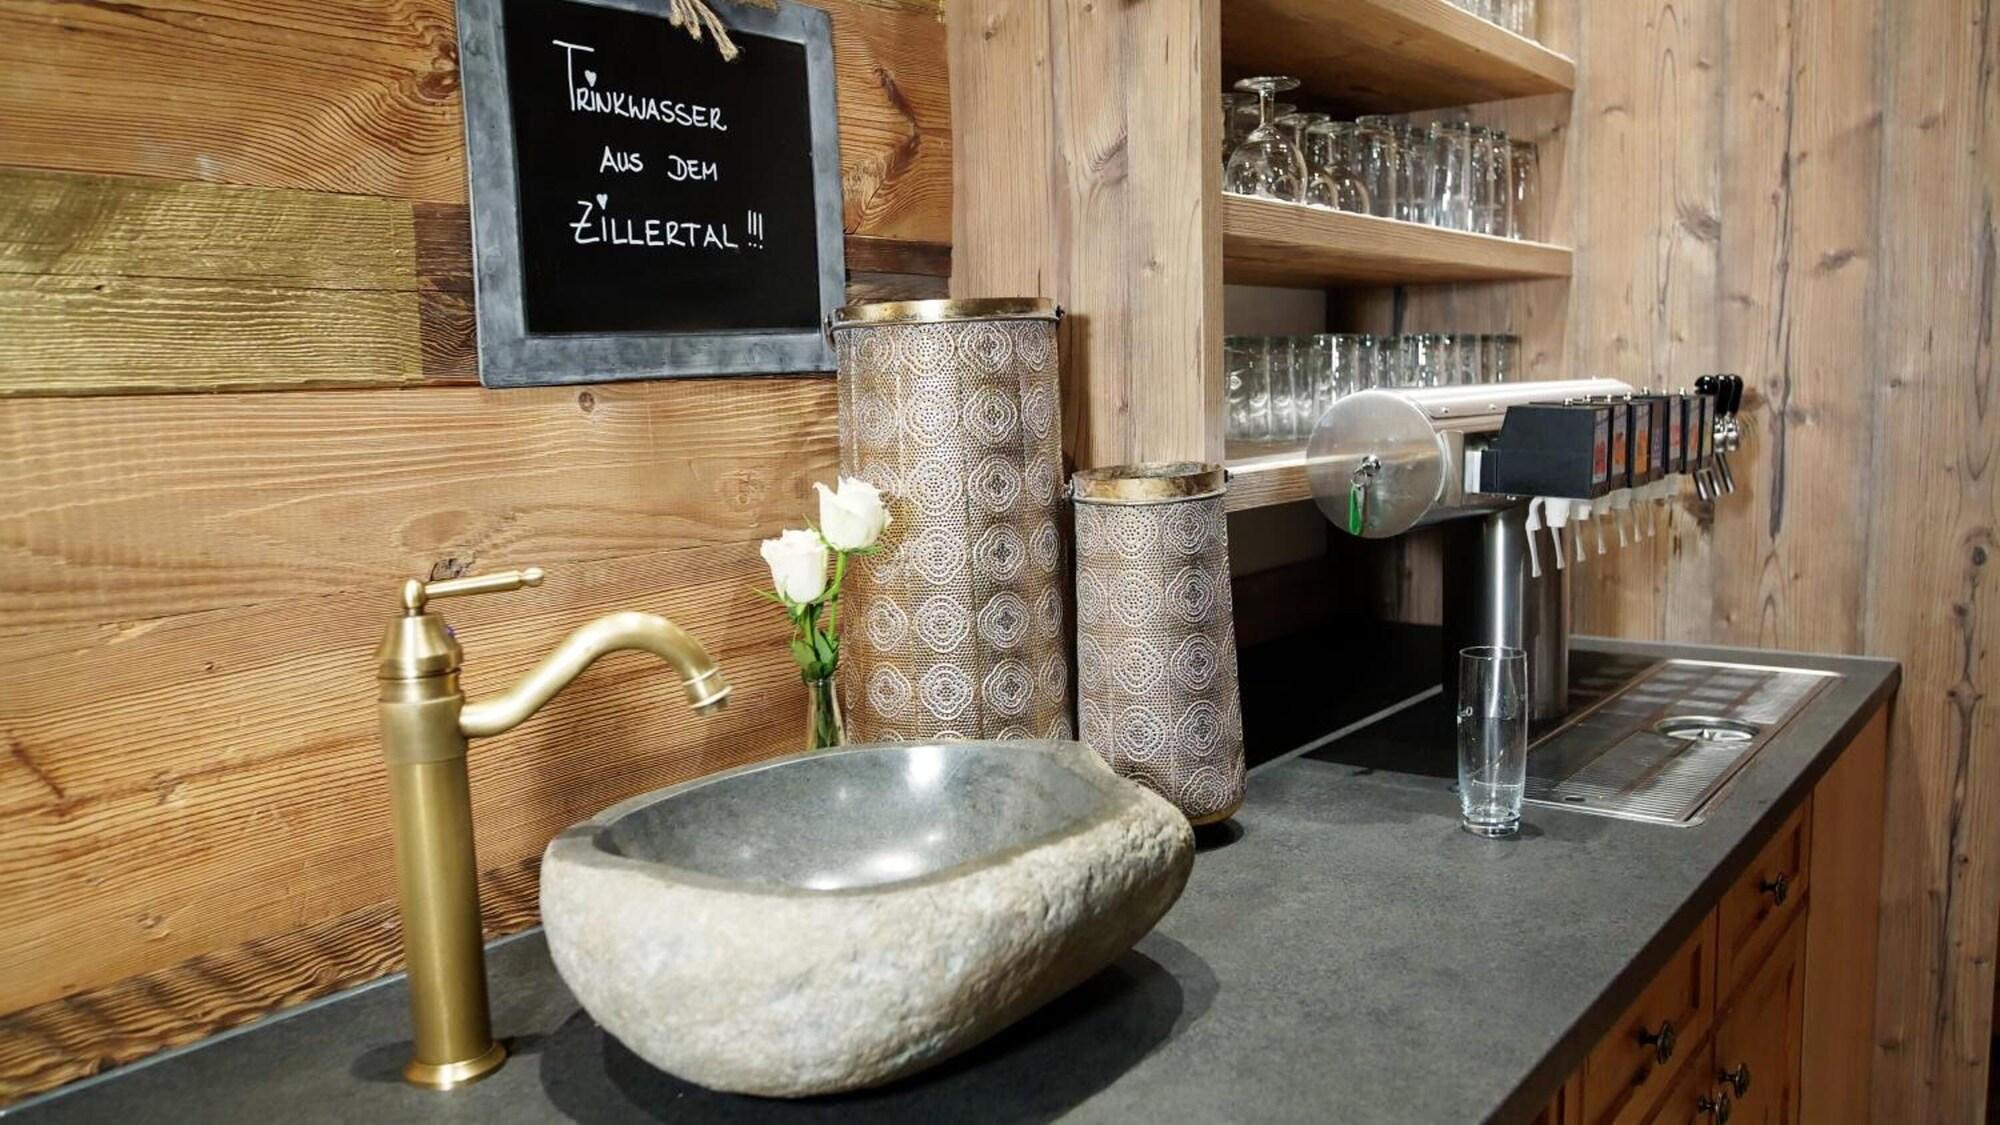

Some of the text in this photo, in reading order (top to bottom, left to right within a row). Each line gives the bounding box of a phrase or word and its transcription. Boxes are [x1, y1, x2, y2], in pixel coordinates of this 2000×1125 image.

[552, 39, 728, 132] TRINKWASSER
[599, 145, 718, 181] AUS DEM
